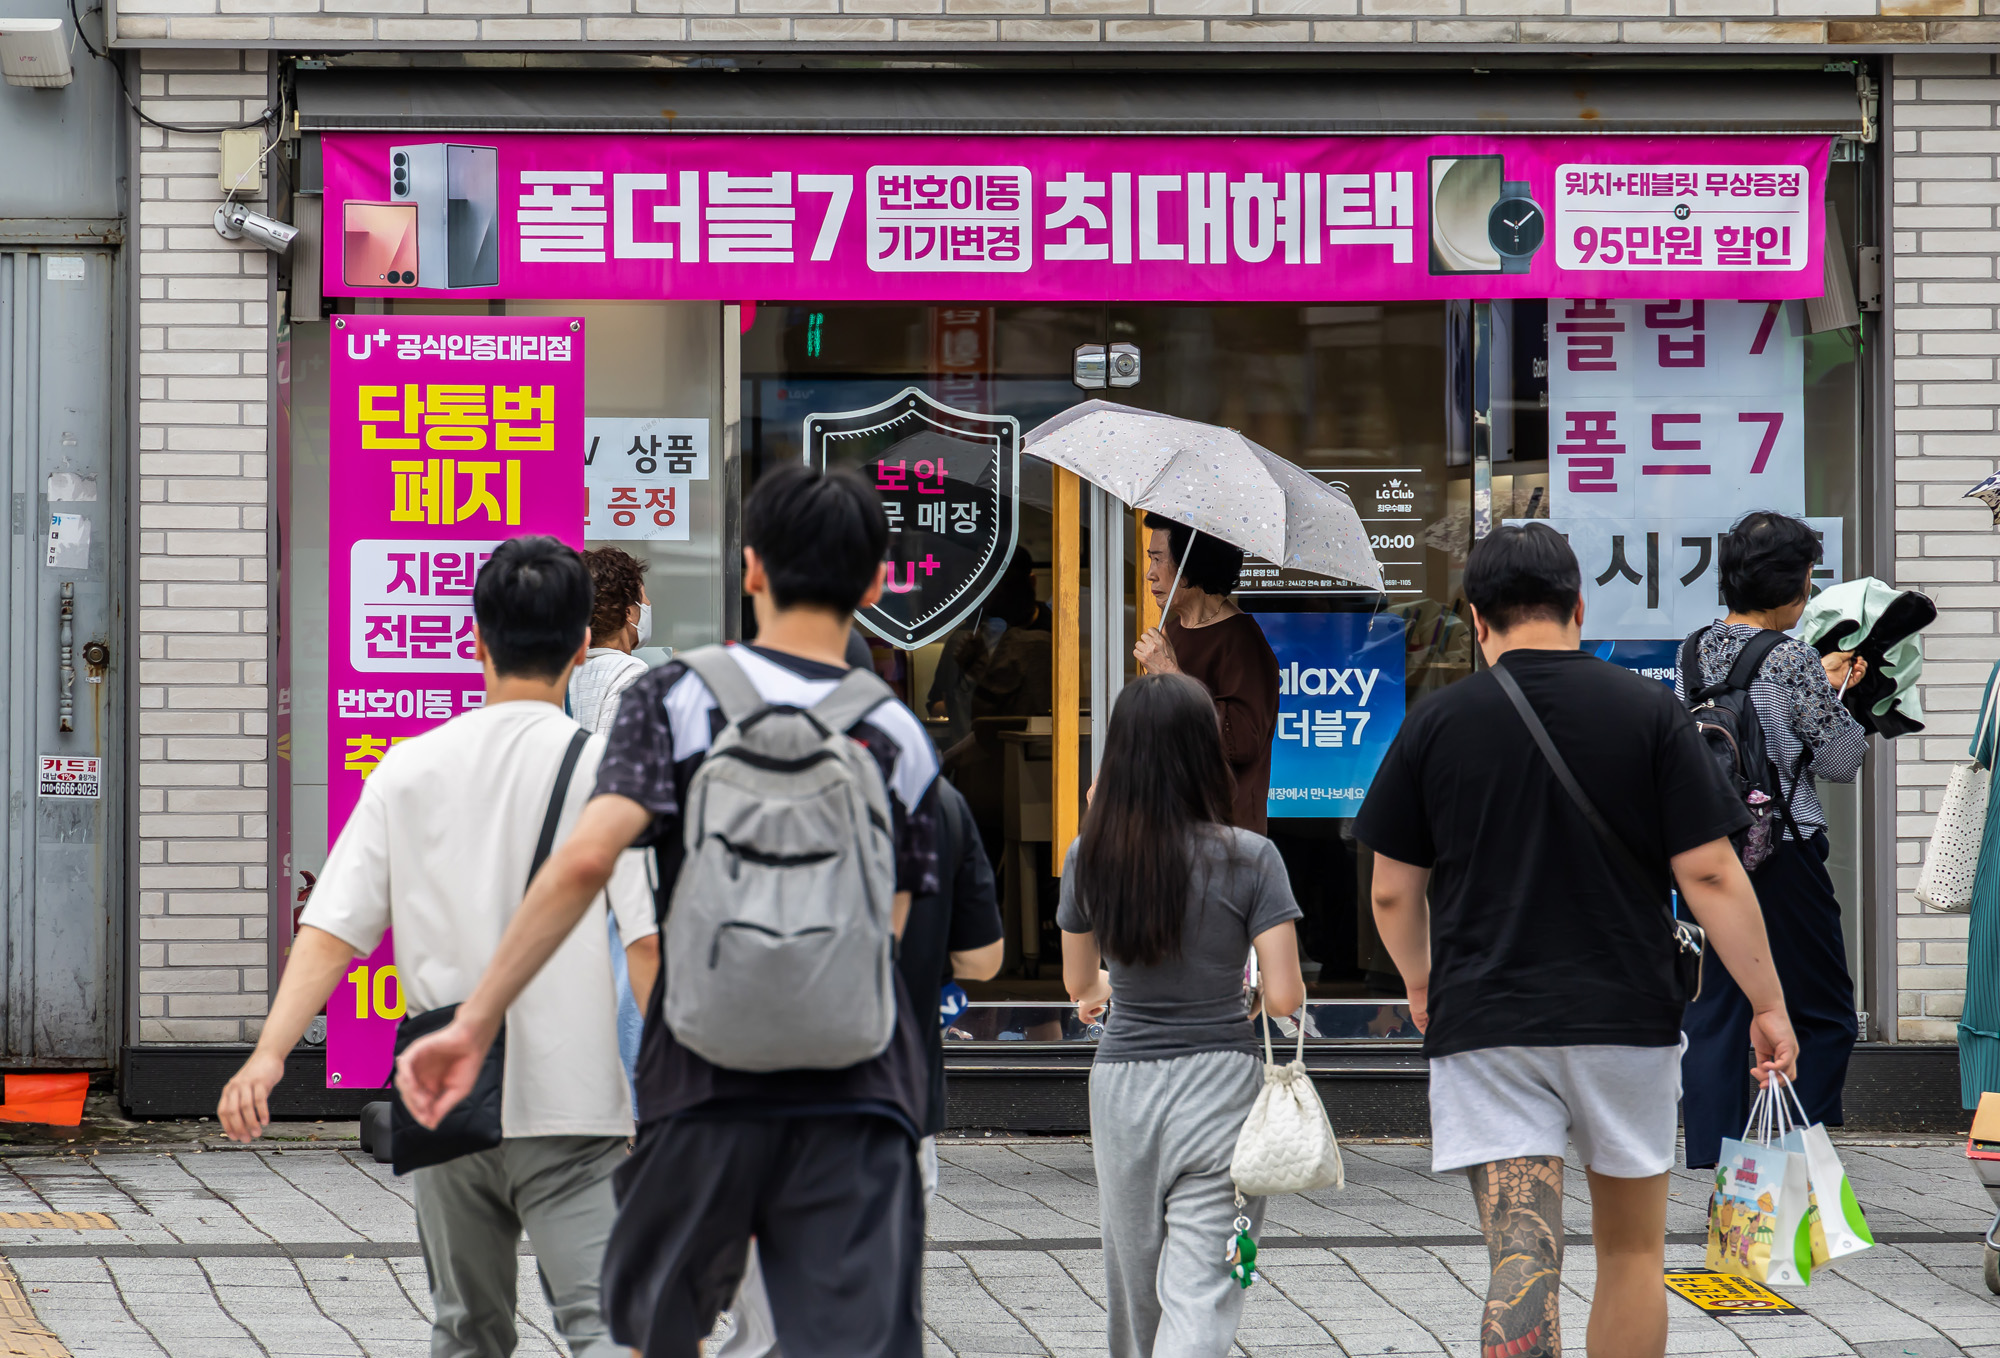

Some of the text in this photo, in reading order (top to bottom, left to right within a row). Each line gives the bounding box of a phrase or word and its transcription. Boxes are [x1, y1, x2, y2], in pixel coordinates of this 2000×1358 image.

[877, 174, 1021, 212] 번호이동
[1565, 171, 1801, 197] 워치+태블릿 무상증정
[517, 170, 854, 264] 폴더블7
[1043, 171, 1415, 265] 최대혜택
[1675, 206, 1690, 218] or
[877, 224, 1021, 262] 기기변경
[1573, 225, 1792, 265] 95만원 할인
[347, 329, 572, 362] U+ 공식인증대리점
[358, 383, 555, 452] 단통법
[627, 434, 698, 474] 상품
[1557, 411, 1785, 493] 폴드 7
[390, 458, 521, 526] 폐지
[875, 457, 949, 494] 보안
[1376, 489, 1415, 499] LG Club
[607, 486, 676, 527] 증정
[917, 501, 981, 534] 매장
[1370, 534, 1415, 549] 20:00
[386, 551, 491, 597] 지원
[886, 553, 941, 594] U+
[337, 689, 453, 719] 번호이동
[1310, 788, 1365, 800] 만나보세요
